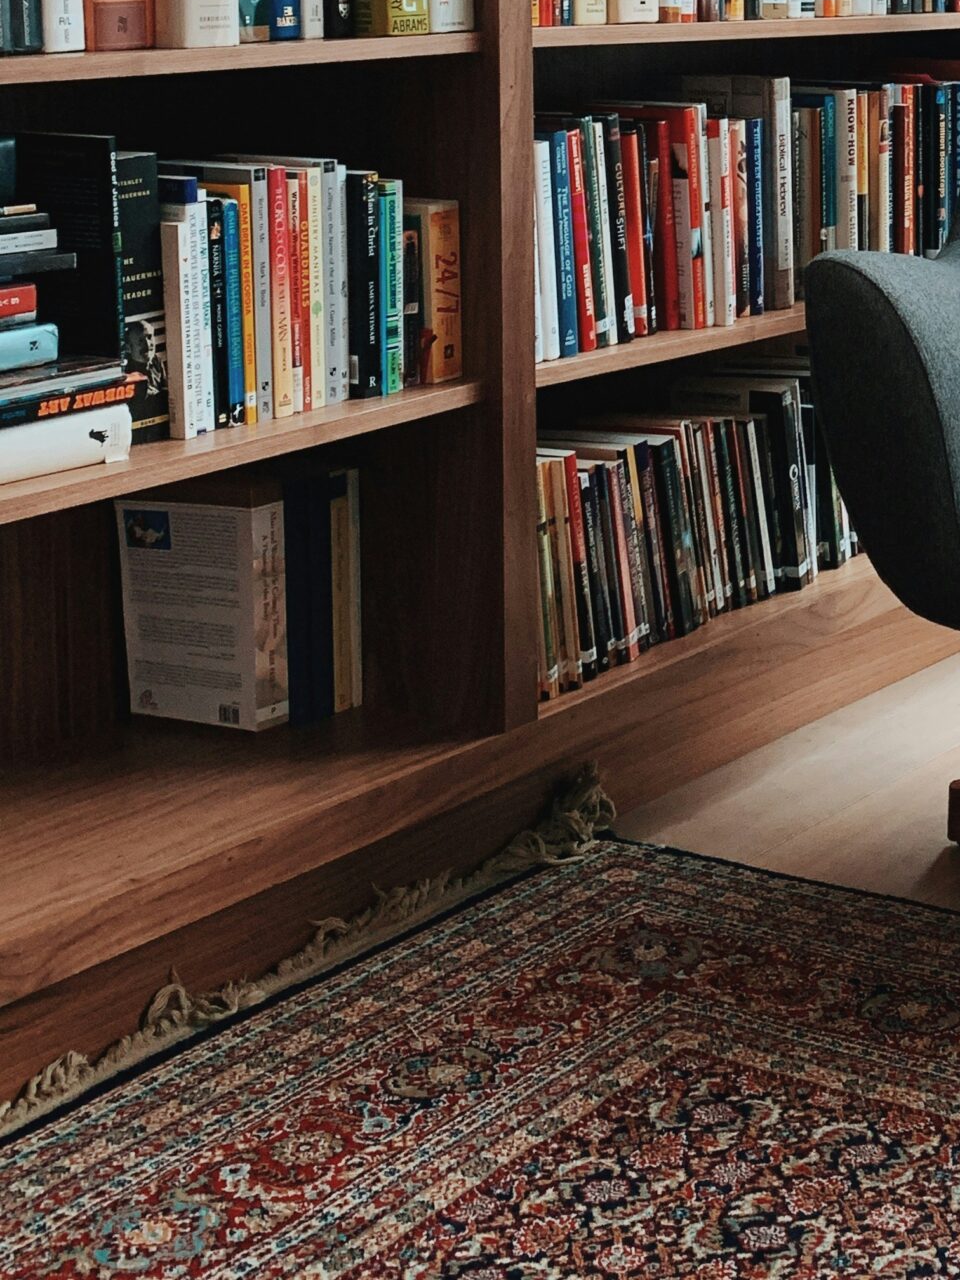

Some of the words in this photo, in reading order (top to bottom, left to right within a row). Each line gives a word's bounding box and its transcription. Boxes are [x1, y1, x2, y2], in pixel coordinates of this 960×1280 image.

[392, 19, 428, 33] ABRAMS
[779, 134, 788, 172] Biblical
[368, 182, 377, 190] A
[780, 176, 789, 218] Hebrew
[112, 188, 120, 227] Justice
[240, 202, 248, 225] DAM
[367, 192, 375, 214] Man
[368, 215, 376, 225] in
[563, 209, 571, 256] LANGUAGE
[241, 228, 250, 256] BREAK
[368, 227, 378, 257] Christ
[243, 259, 250, 270] IN
[300, 221, 309, 308] GUARDRAILS
[565, 259, 571, 272] OF
[244, 273, 252, 316] GEORGIA
[434, 251, 460, 315] 24/7
[38, 397, 70, 417] ART
[73, 384, 135, 409] SUBWAY
